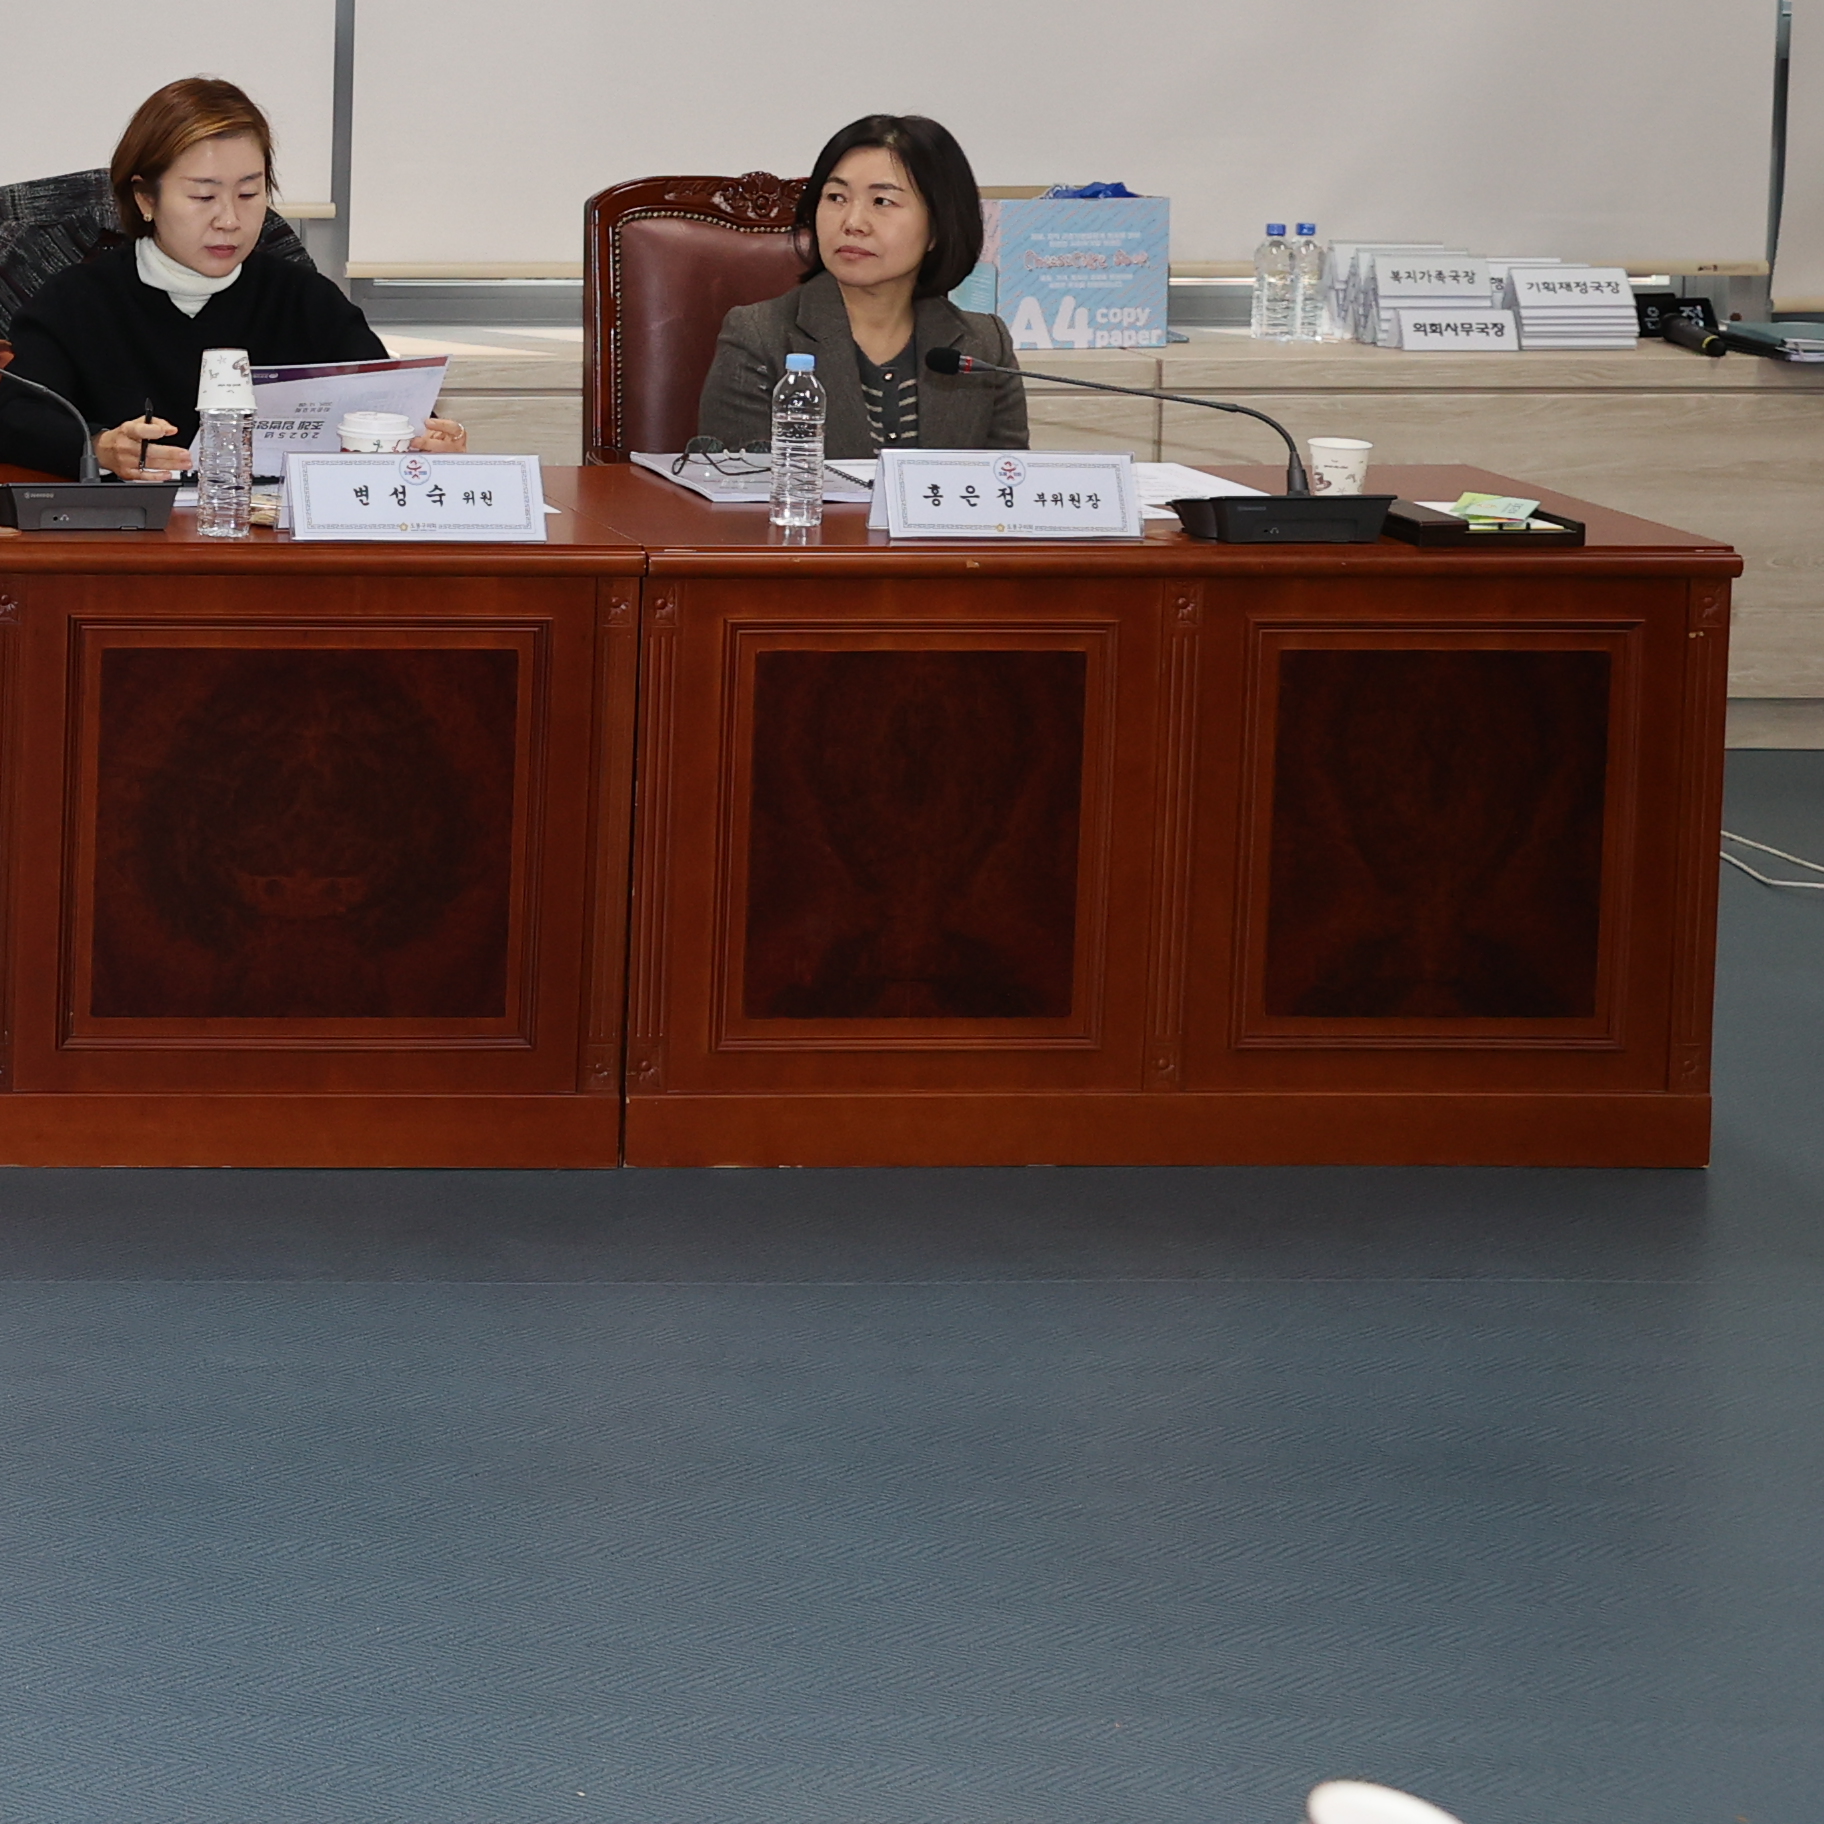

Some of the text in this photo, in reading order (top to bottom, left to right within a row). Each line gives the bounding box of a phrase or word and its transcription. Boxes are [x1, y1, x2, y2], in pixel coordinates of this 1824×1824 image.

[1390, 269, 1476, 284] 복지가족국장
[1526, 280, 1620, 295] 기획재정국장
[1010, 295, 1093, 348] A4
[1096, 307, 1150, 327] copy
[1095, 328, 1162, 347] paper
[1412, 322, 1506, 337] 의회사무국장
[462, 490, 493, 506] 위원
[1033, 491, 1101, 510] 부위원장
